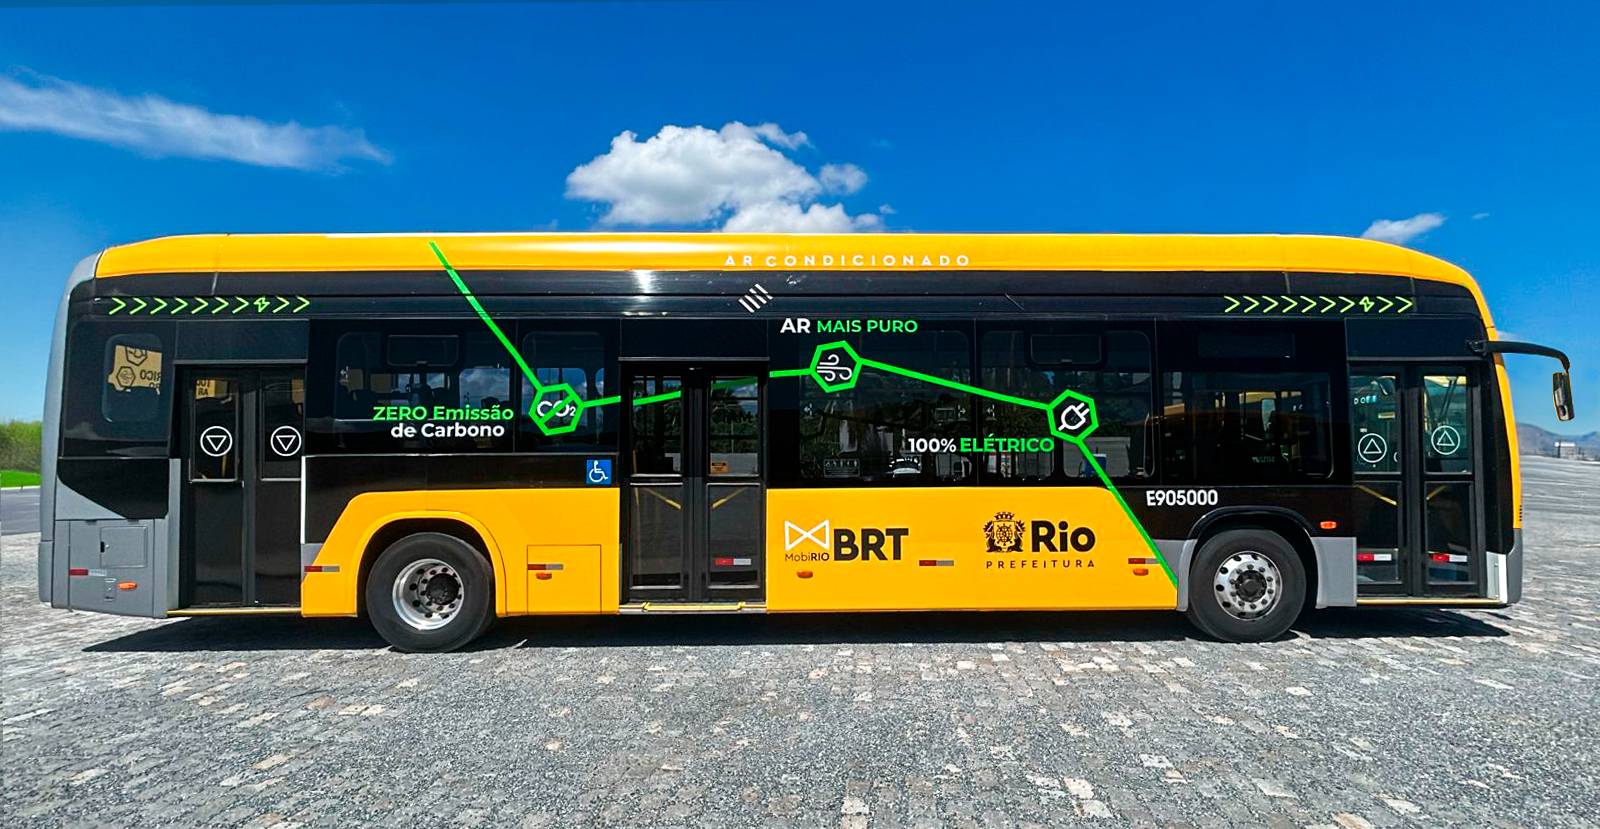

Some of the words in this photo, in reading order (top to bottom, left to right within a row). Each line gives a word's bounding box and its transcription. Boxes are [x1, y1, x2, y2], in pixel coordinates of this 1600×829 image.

[724, 255, 753, 267] AR
[765, 254, 970, 267] CONDICIONADO
[780, 318, 811, 333] AR
[817, 319, 862, 333] MAIS
[867, 319, 918, 333] PURO
[373, 406, 427, 421] ZERO
[433, 404, 514, 421] Emissão
[391, 422, 417, 438] de
[421, 422, 505, 438] Carbono
[908, 437, 957, 453] 100%
[960, 433, 1055, 453] ELÉTRICO
[1146, 489, 1219, 506] E905000
[833, 528, 909, 561] BRT
[1031, 520, 1096, 553] Rio
[784, 552, 830, 562] MobiRIO
[985, 559, 1095, 569] PREFEITURA
